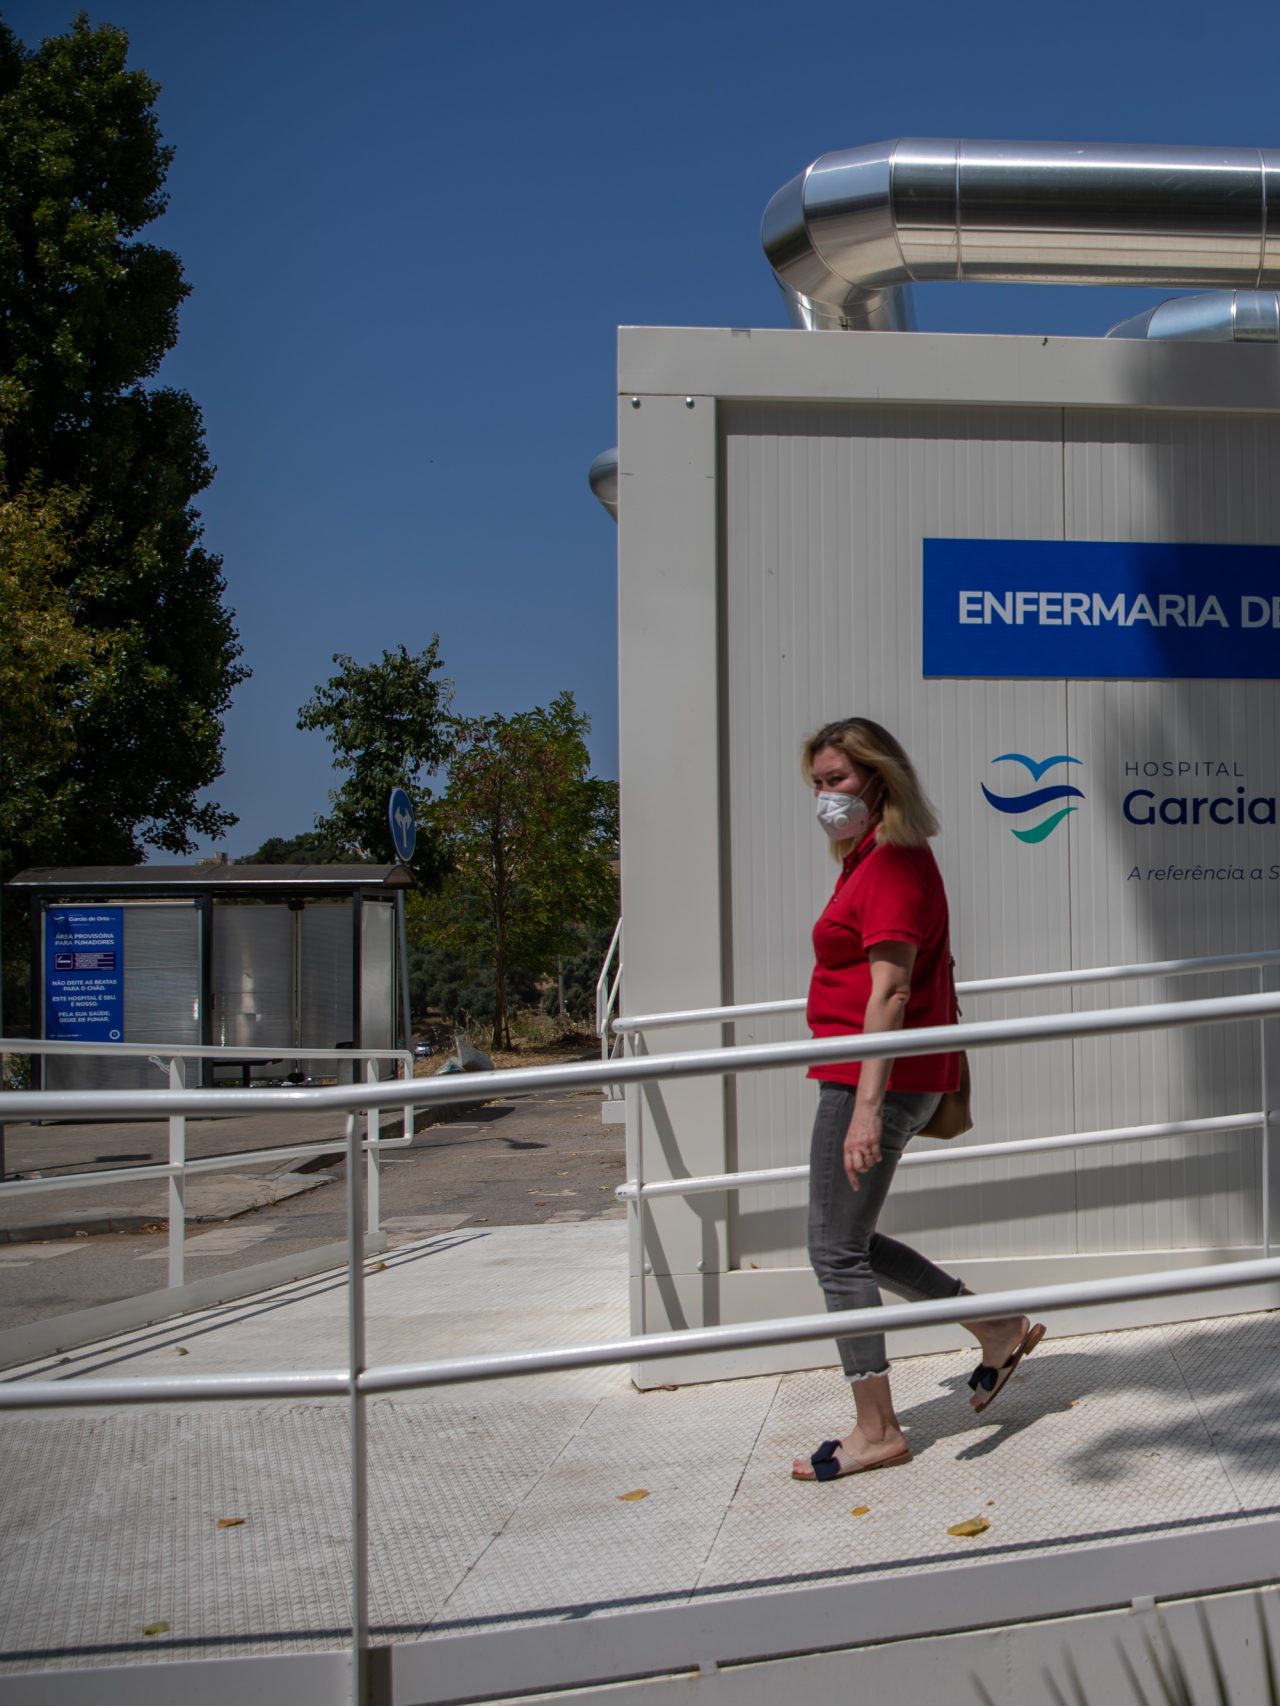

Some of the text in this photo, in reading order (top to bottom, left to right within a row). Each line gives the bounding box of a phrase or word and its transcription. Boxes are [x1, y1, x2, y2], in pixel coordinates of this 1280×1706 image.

[958, 589, 1230, 629] ENFERMARIA
[1124, 760, 1246, 778] HOSPITAL
[1122, 786, 1277, 826] Garcia
[1127, 865, 1142, 882] A
[1147, 864, 1246, 882] referência
[1249, 868, 1264, 881] a
